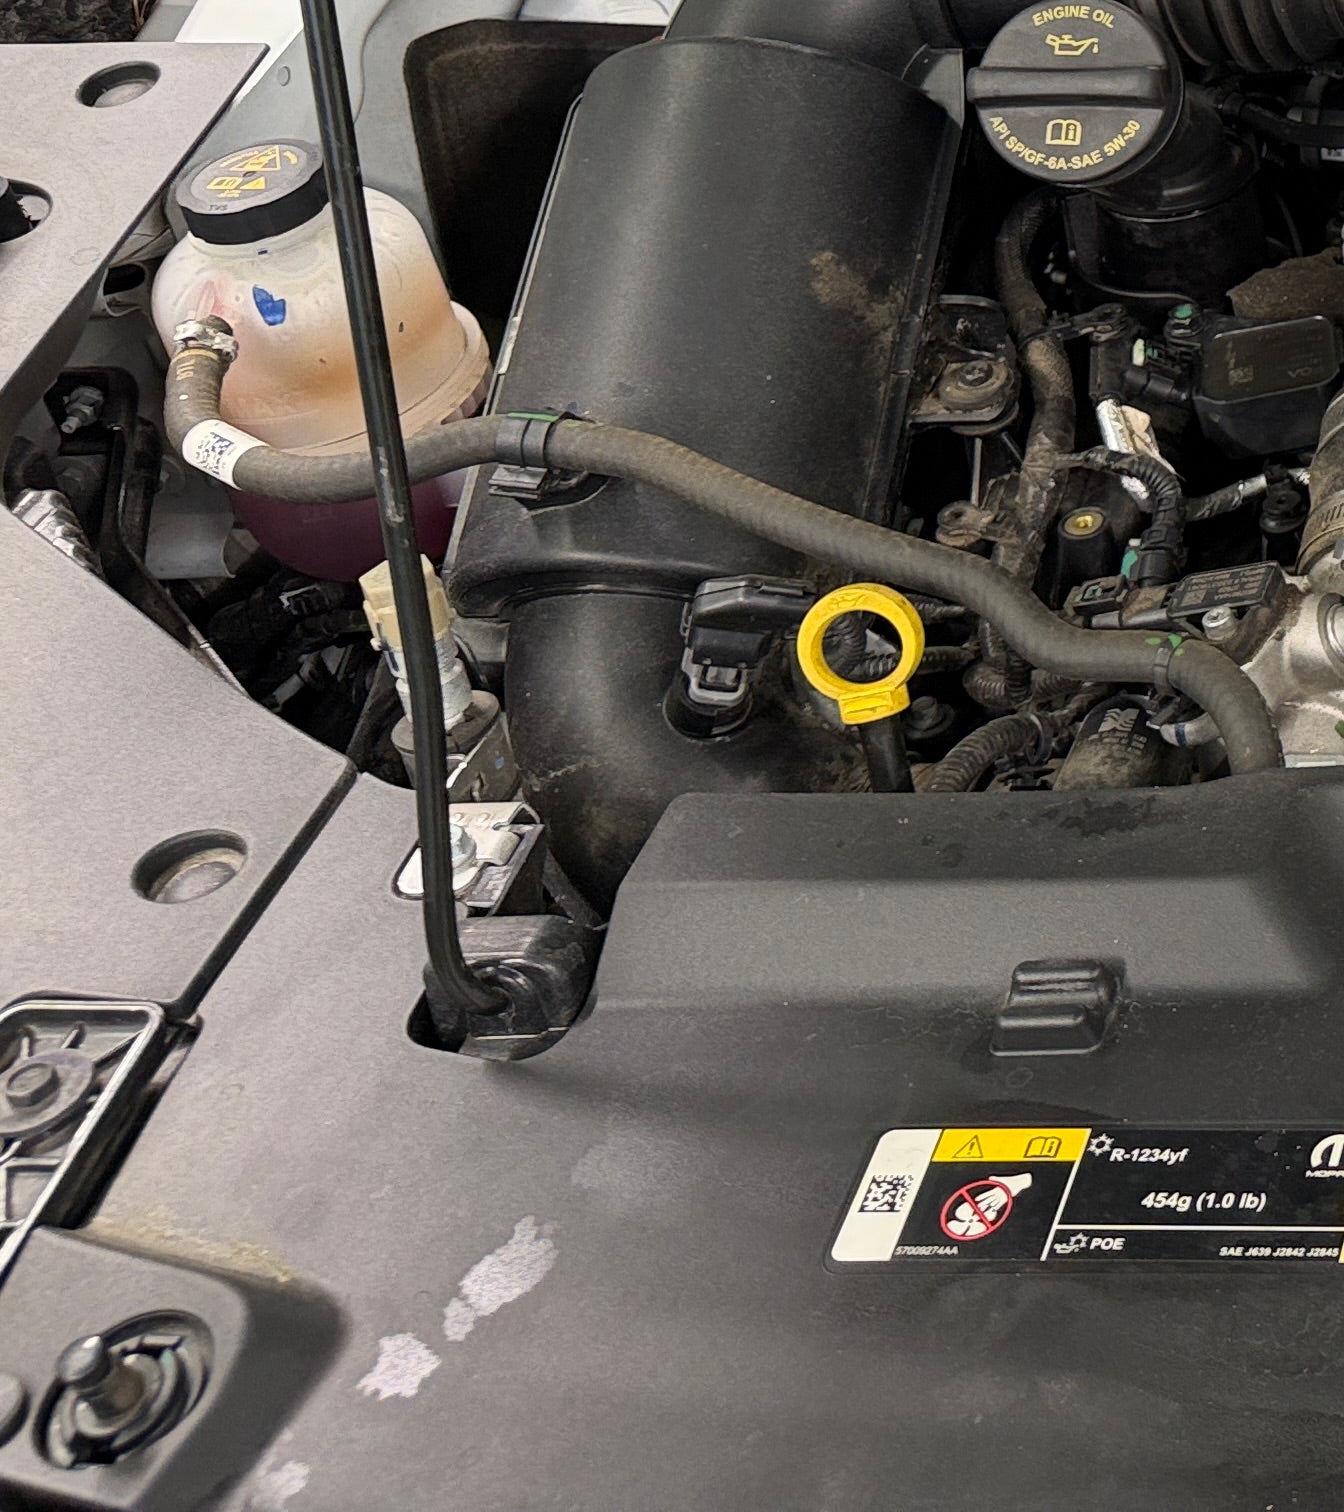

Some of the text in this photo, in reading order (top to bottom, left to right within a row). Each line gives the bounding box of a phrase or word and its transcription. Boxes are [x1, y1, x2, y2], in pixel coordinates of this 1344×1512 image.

[1032, 5, 1115, 29] ENGINE OIL
[990, 116, 1010, 140] API
[1103, 119, 1142, 157] 5W-30
[1109, 1146, 1188, 1166] R-1234yf
[1141, 1192, 1267, 1212] 454g (1.0 lb)
[1090, 1236, 1125, 1251] POE
[1219, 1246, 1245, 1256] SAE
